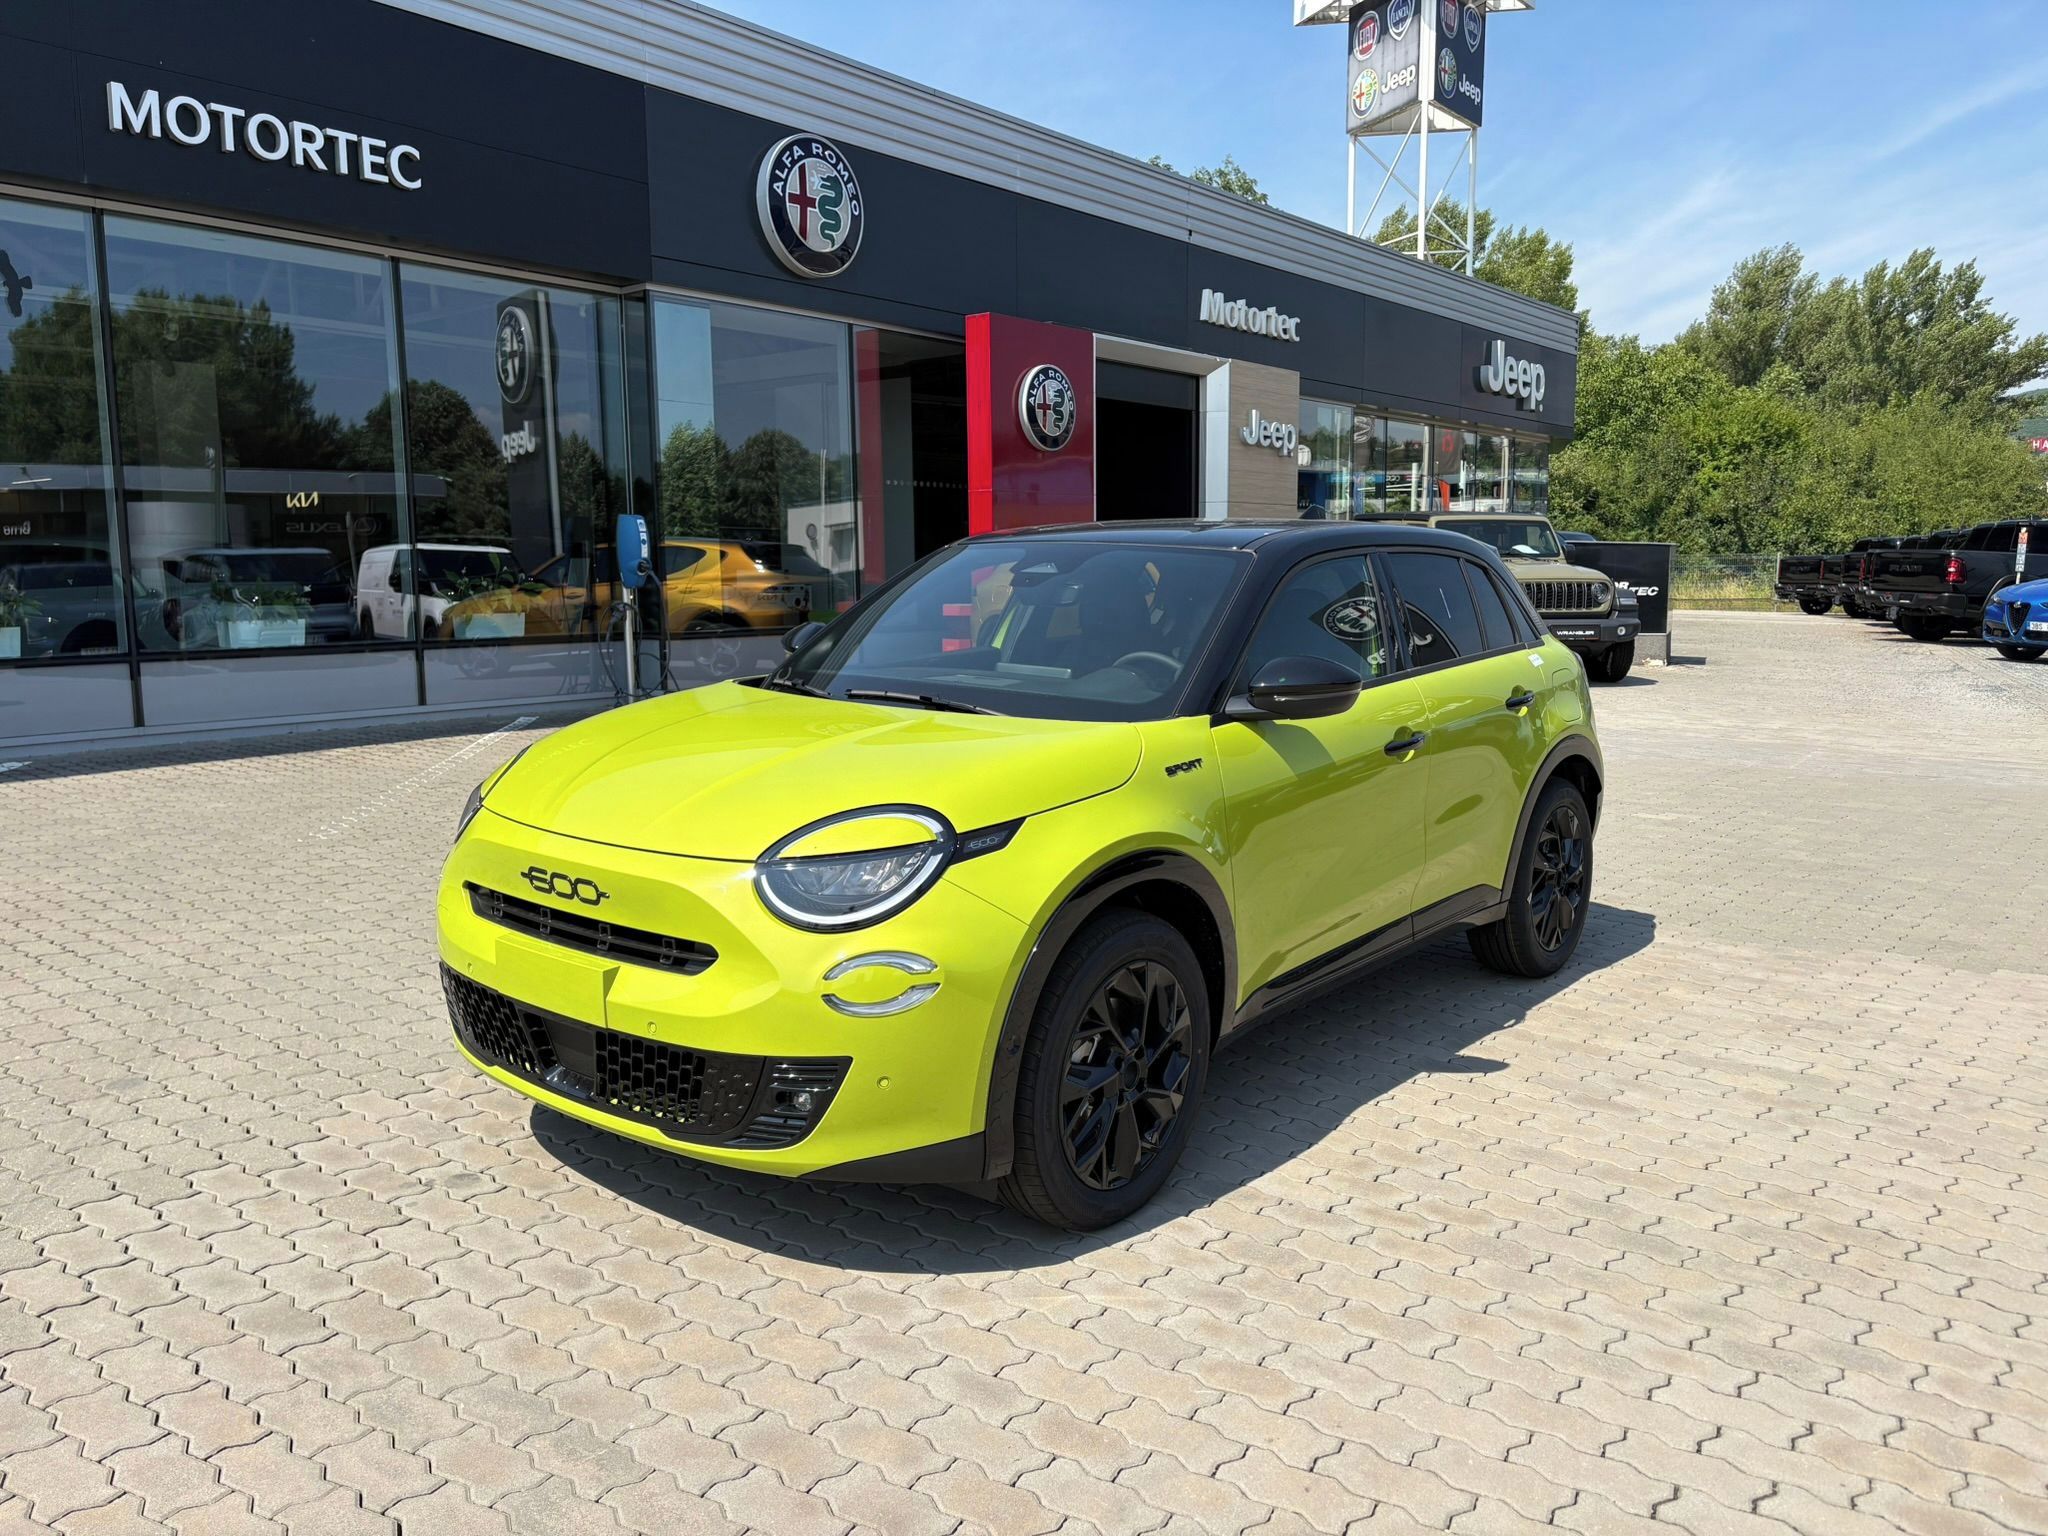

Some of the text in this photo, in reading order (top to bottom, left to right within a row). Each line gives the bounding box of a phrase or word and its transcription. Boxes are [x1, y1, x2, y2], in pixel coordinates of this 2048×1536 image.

[1444, 0, 1456, 27] FIAT
[1359, 22, 1375, 50] FIAT
[1381, 64, 1416, 94] Jeep
[1458, 73, 1481, 106] Jeep
[106, 81, 422, 191] MOTORTEC
[773, 142, 860, 216] ALFA ROMEO
[1200, 288, 1301, 342] Motortec
[1028, 369, 1074, 411] ALFA ROMEO
[1479, 339, 1546, 413] Jeep
[1242, 409, 1296, 457] Jeep
[1164, 757, 1204, 776] SPORT
[967, 835, 1002, 849] 600
[520, 865, 610, 906] 600
